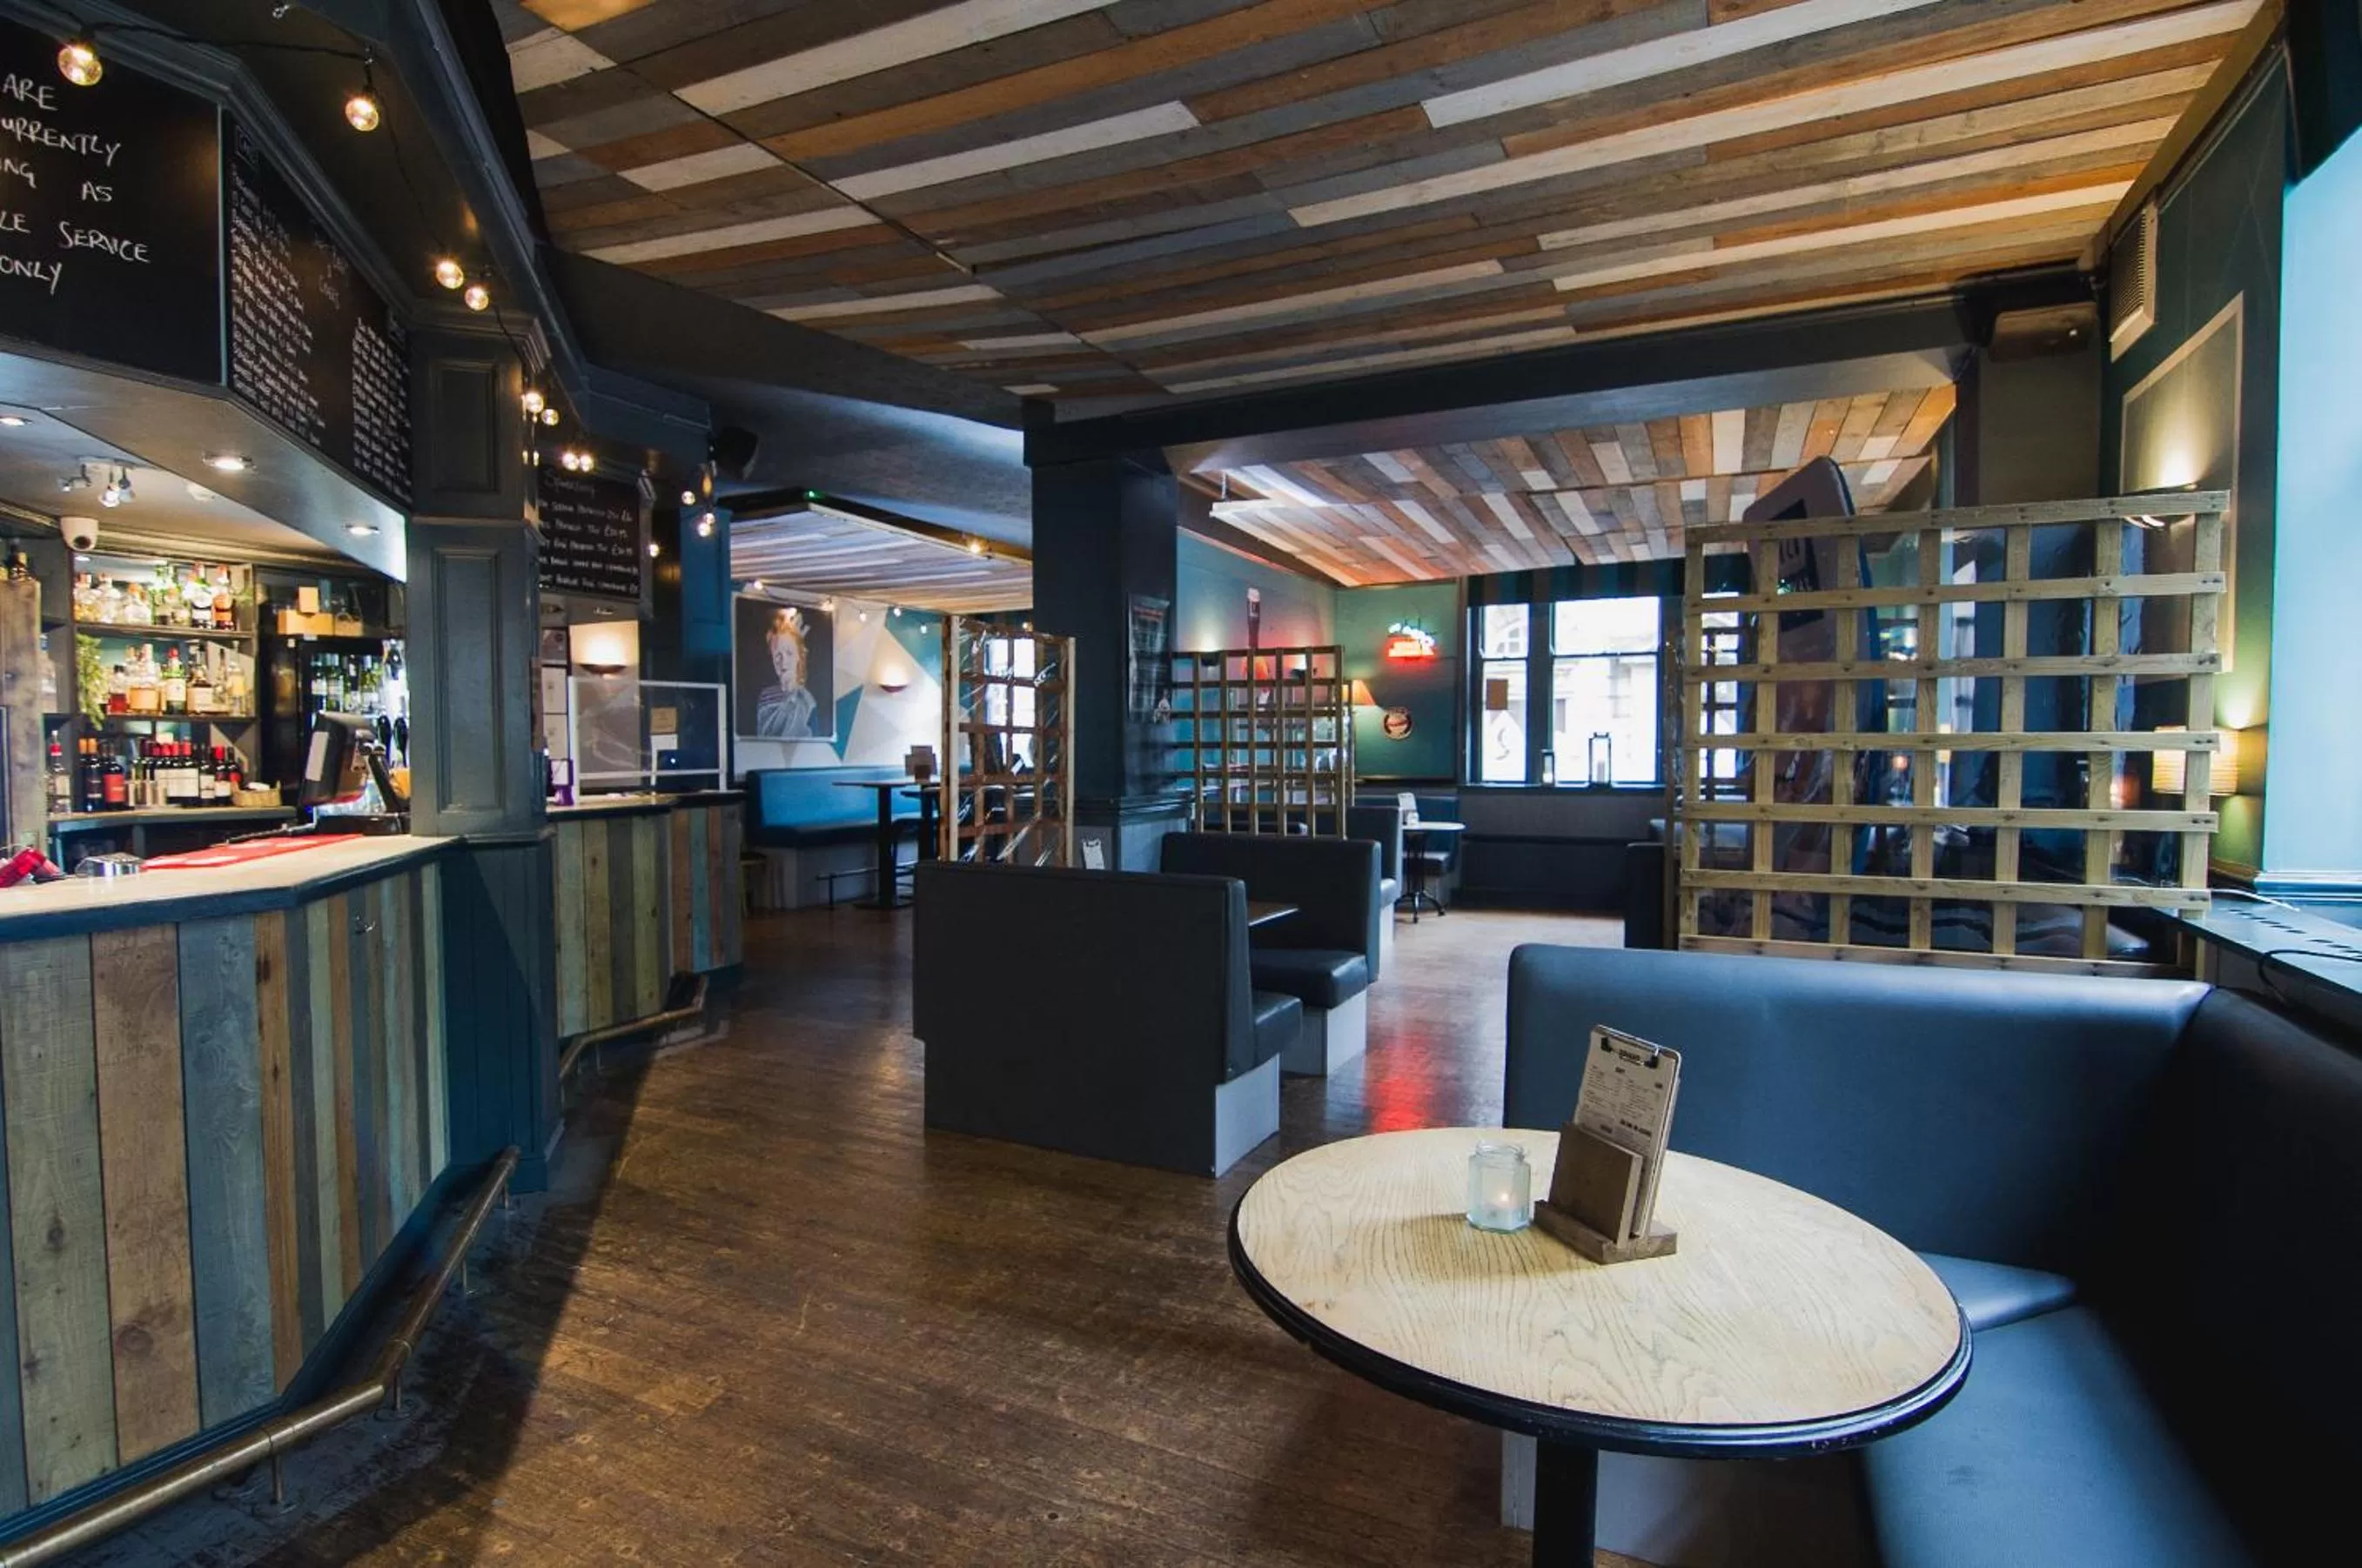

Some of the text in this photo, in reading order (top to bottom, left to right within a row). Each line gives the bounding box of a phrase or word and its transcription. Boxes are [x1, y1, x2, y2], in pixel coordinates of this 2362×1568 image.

[2, 72, 58, 111] ARE
[0, 117, 121, 167] URRENTLY
[82, 180, 112, 202] AS
[0, 211, 151, 263] LE SERVICE
[0, 256, 62, 295] ONLY
